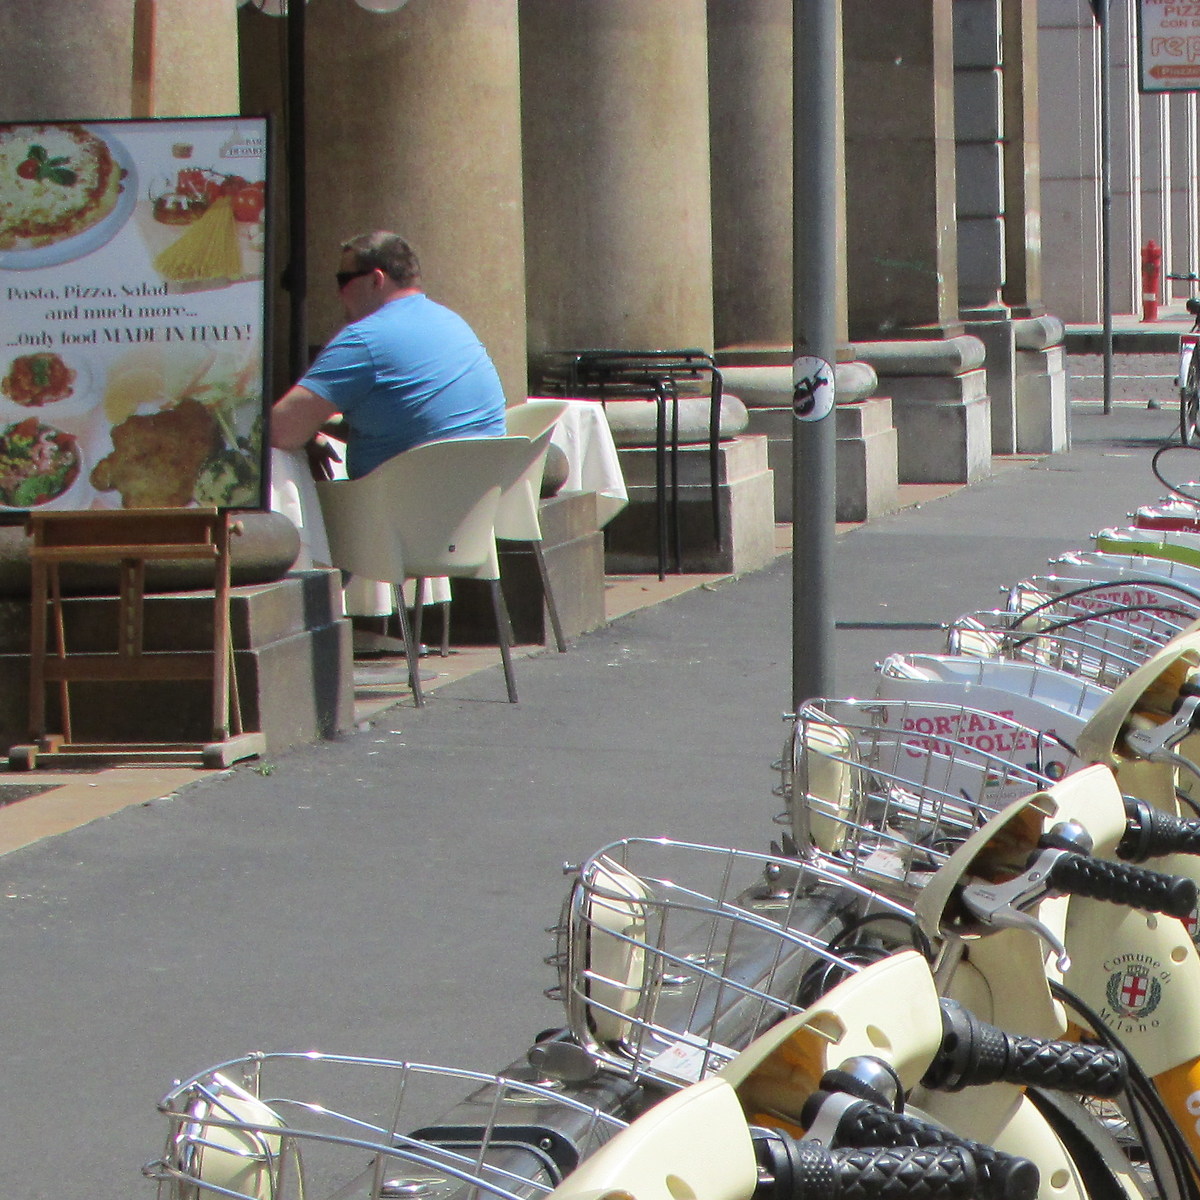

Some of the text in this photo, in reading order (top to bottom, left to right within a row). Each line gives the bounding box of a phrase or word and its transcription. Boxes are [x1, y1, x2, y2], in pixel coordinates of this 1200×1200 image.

[1160, 20, 1187, 28] CON
[7, 281, 169, 301] Pasta, Pizza, Salad
[45, 305, 79, 321] and
[84, 304, 133, 319] much
[61, 329, 97, 345] food
[103, 326, 156, 344] MADE
[165, 326, 185, 342] IN
[1103, 953, 1160, 972] Comune
[1099, 1007, 1160, 1033] Milano
